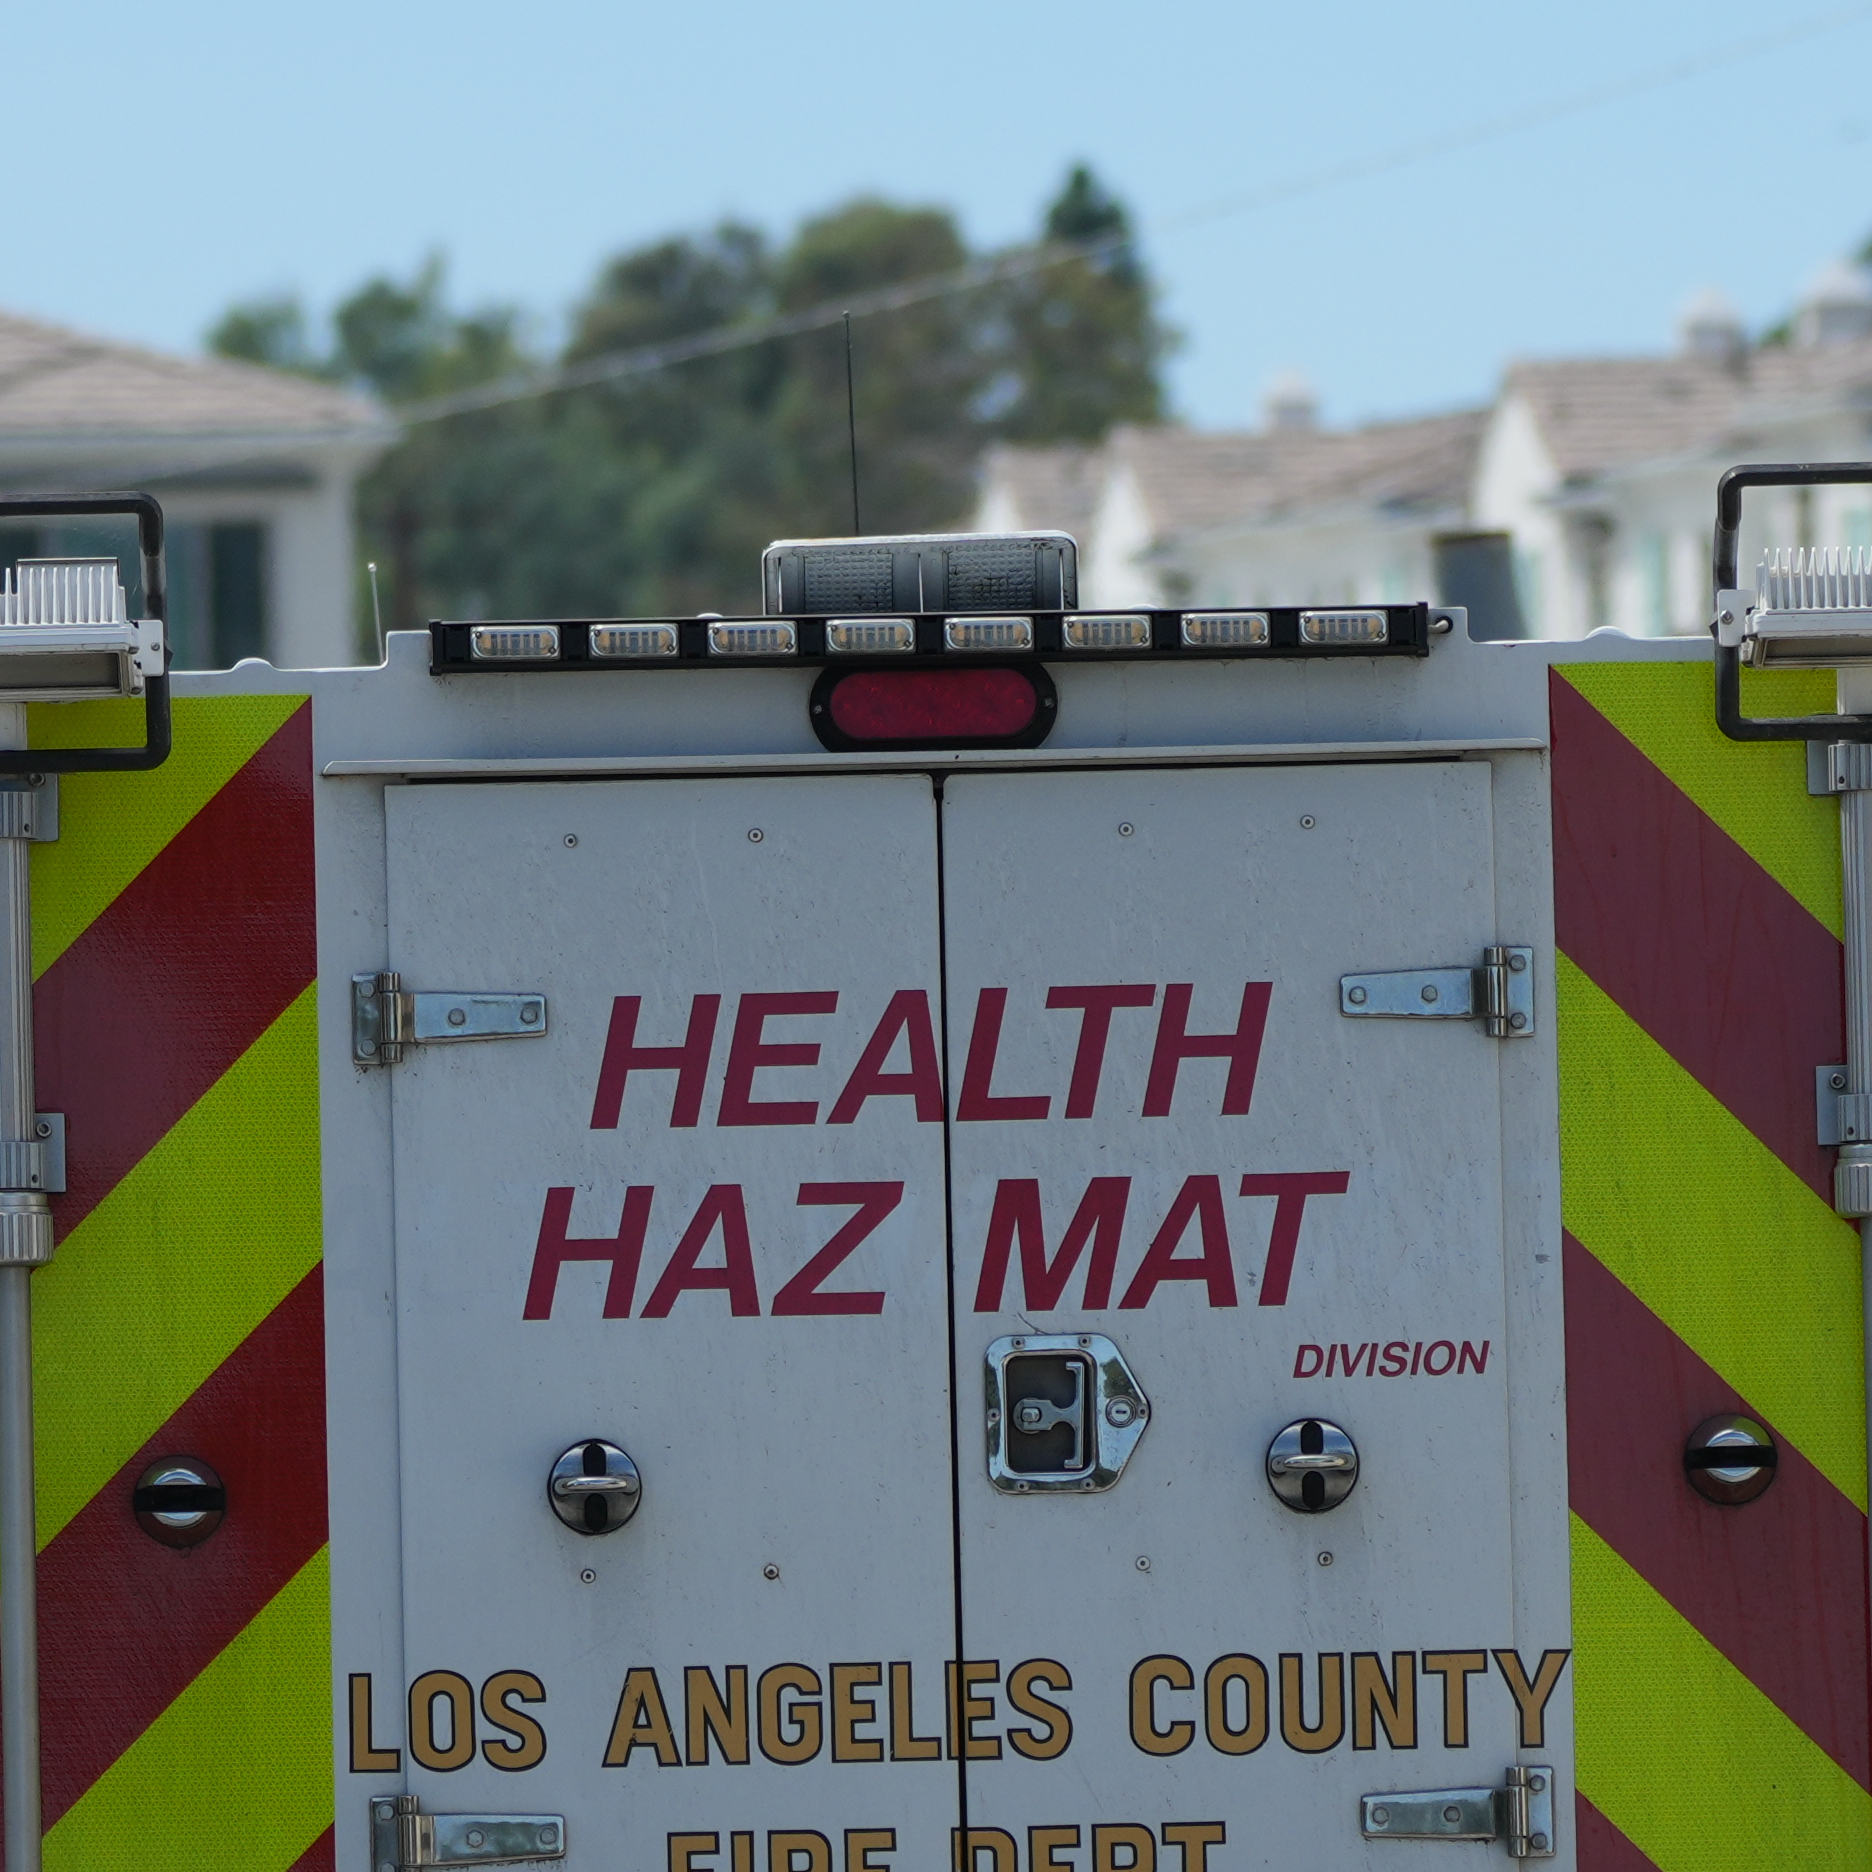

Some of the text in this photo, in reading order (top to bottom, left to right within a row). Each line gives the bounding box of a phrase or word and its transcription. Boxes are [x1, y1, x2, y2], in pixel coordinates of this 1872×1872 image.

[590, 981, 1274, 1130] HEALTH
[522, 1171, 1351, 1321] HAZ MAT
[1292, 1339, 1491, 1380] DIVISION
[347, 1648, 1573, 1773] LOS ANGELES COUNTY
